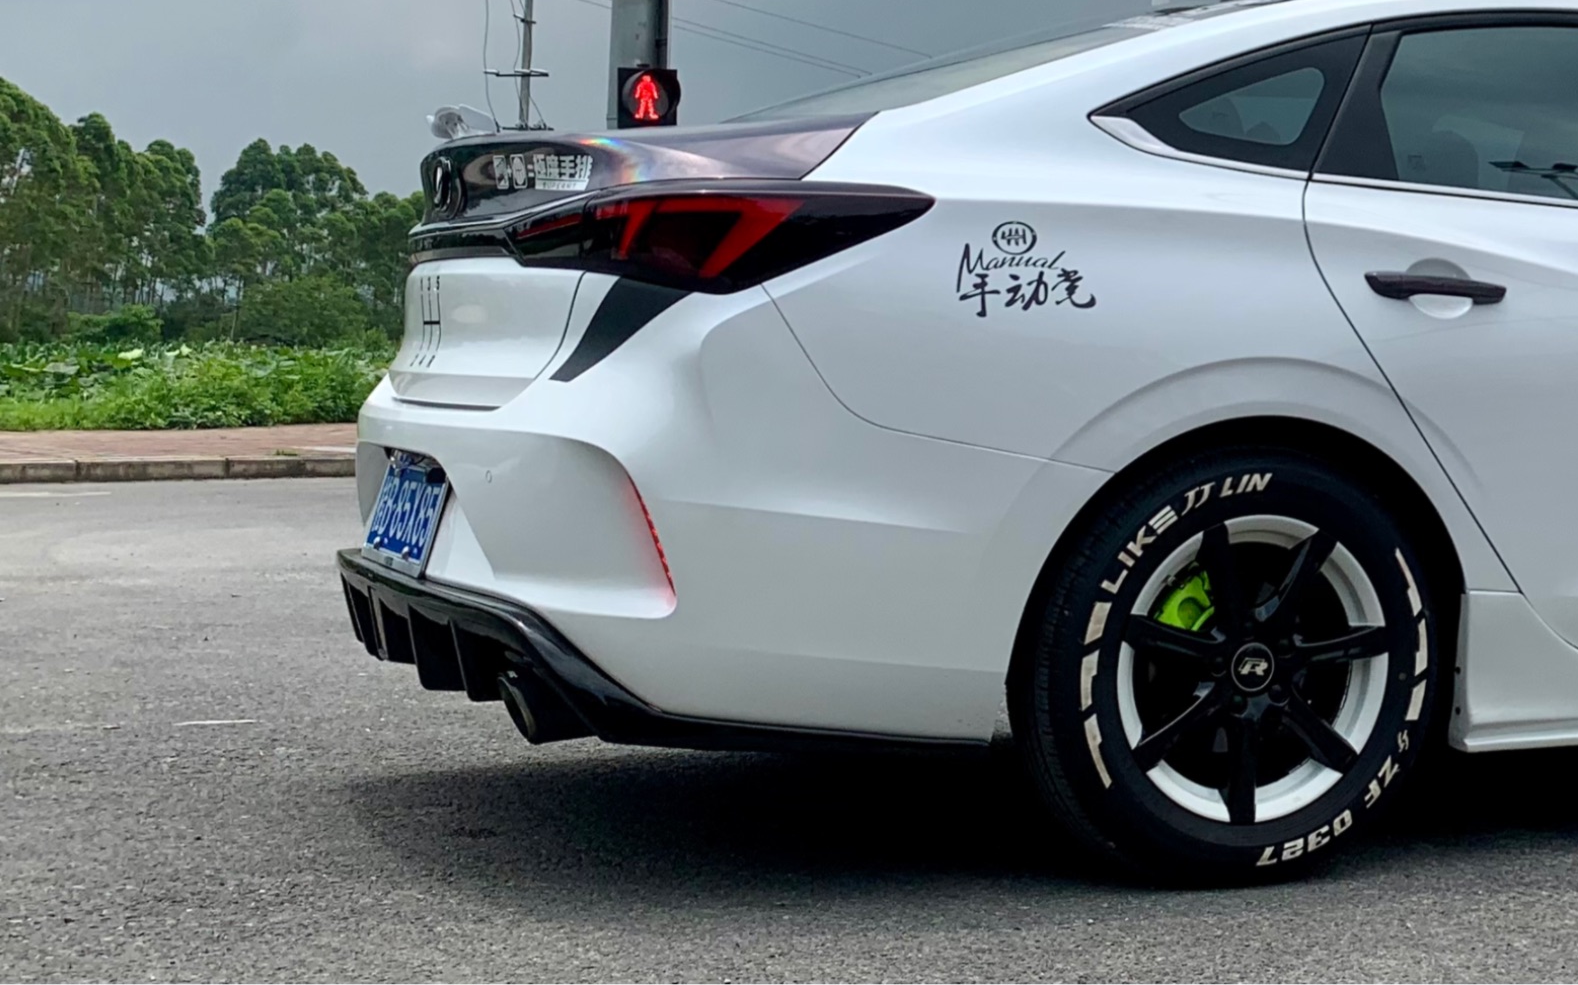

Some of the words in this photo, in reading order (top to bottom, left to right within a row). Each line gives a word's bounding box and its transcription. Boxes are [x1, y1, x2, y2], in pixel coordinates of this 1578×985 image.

[956, 243, 1066, 293] Manual
[1100, 504, 1178, 594] LIKE
[1219, 472, 1273, 497] LIN
[1255, 815, 1353, 867] 0327
